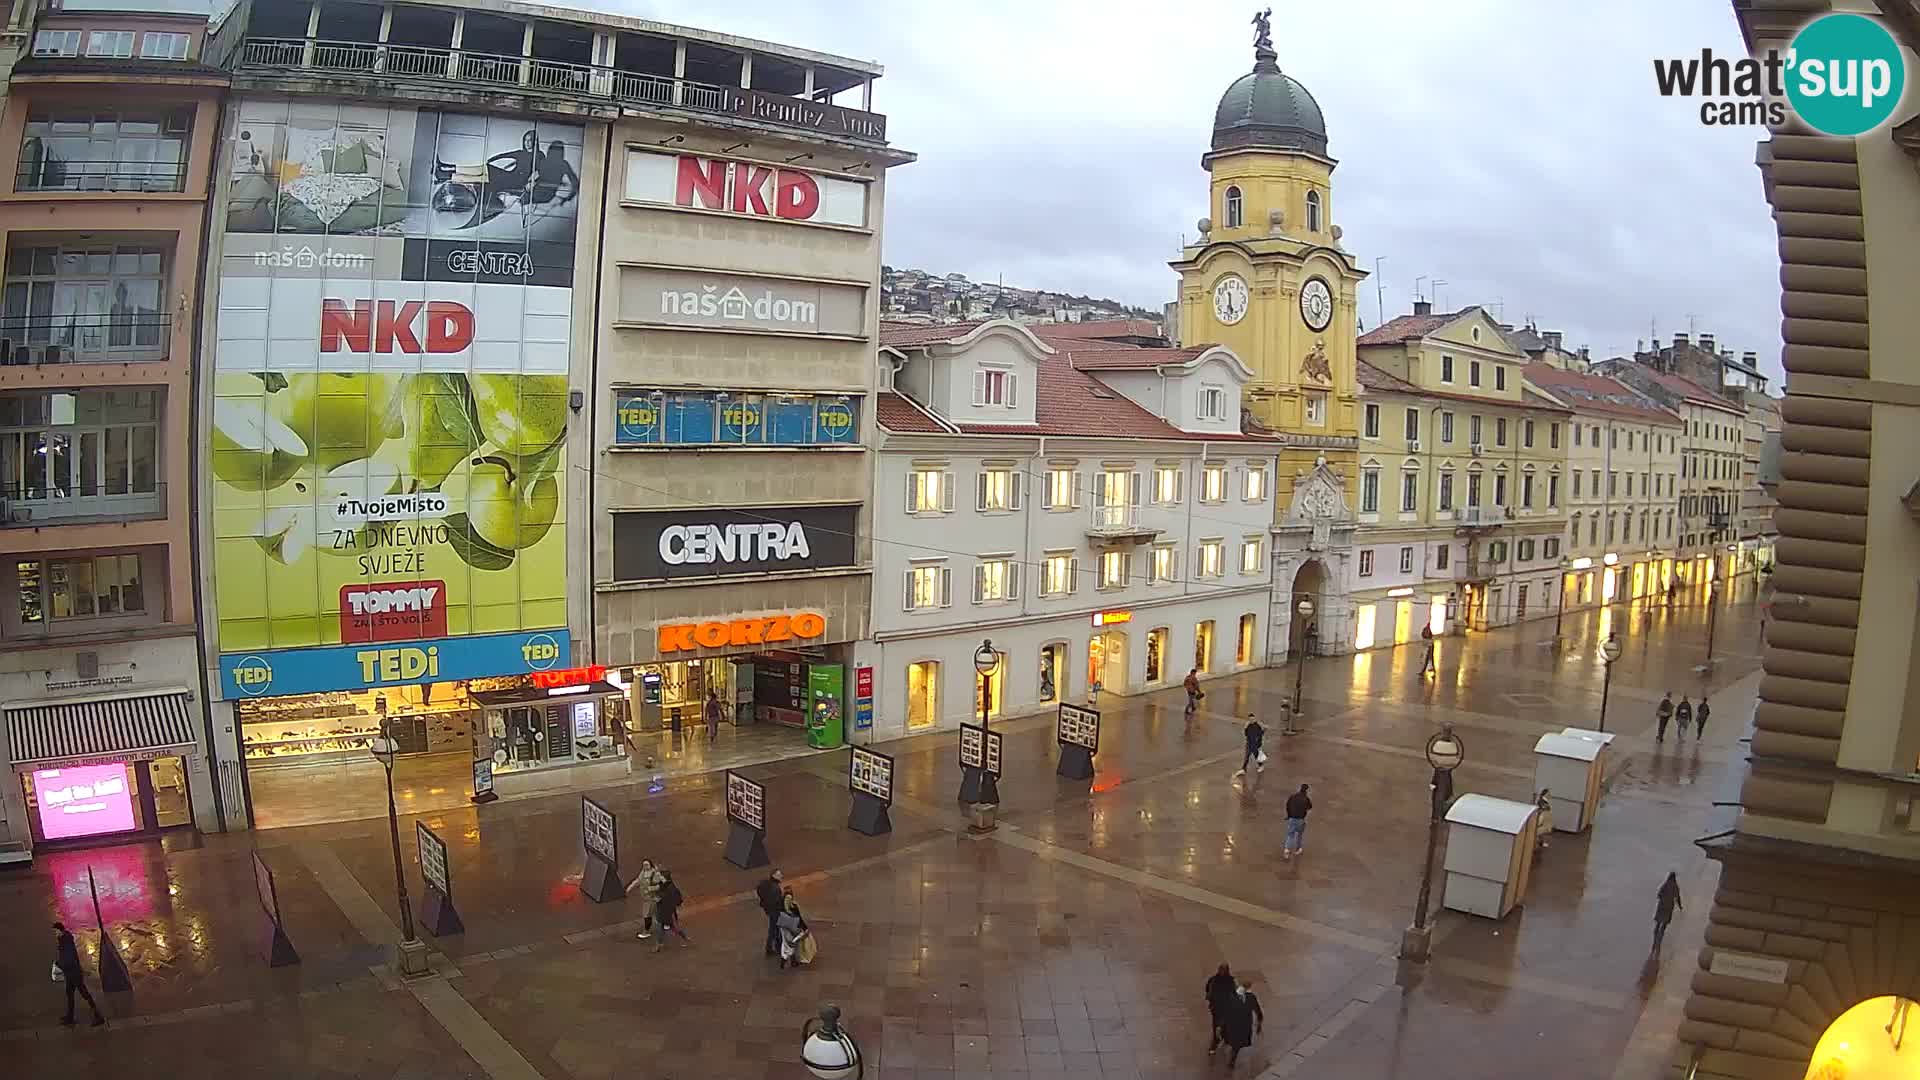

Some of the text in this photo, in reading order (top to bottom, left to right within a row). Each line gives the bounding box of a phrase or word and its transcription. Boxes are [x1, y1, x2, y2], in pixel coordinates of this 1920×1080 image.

[723, 88, 745, 112] Le
[675, 154, 820, 220] NKD
[254, 245, 364, 268] naš dom
[448, 251, 533, 275] CENTRA
[661, 285, 816, 323] naš dom
[320, 298, 476, 353] NKD
[618, 408, 657, 425] TEDi
[724, 409, 759, 426] TEDi
[820, 412, 852, 427] TEDi
[337, 498, 445, 516] #TvojeMisto
[333, 524, 449, 549] ZA DNEVNO
[659, 521, 810, 565] CENTRA
[359, 548, 425, 576] SVJEŽE
[348, 587, 438, 615] TOMMY
[659, 613, 825, 653] KORZO
[522, 643, 559, 661] TEDi
[233, 666, 273, 685] TEDi
[357, 646, 440, 683] TEDi
